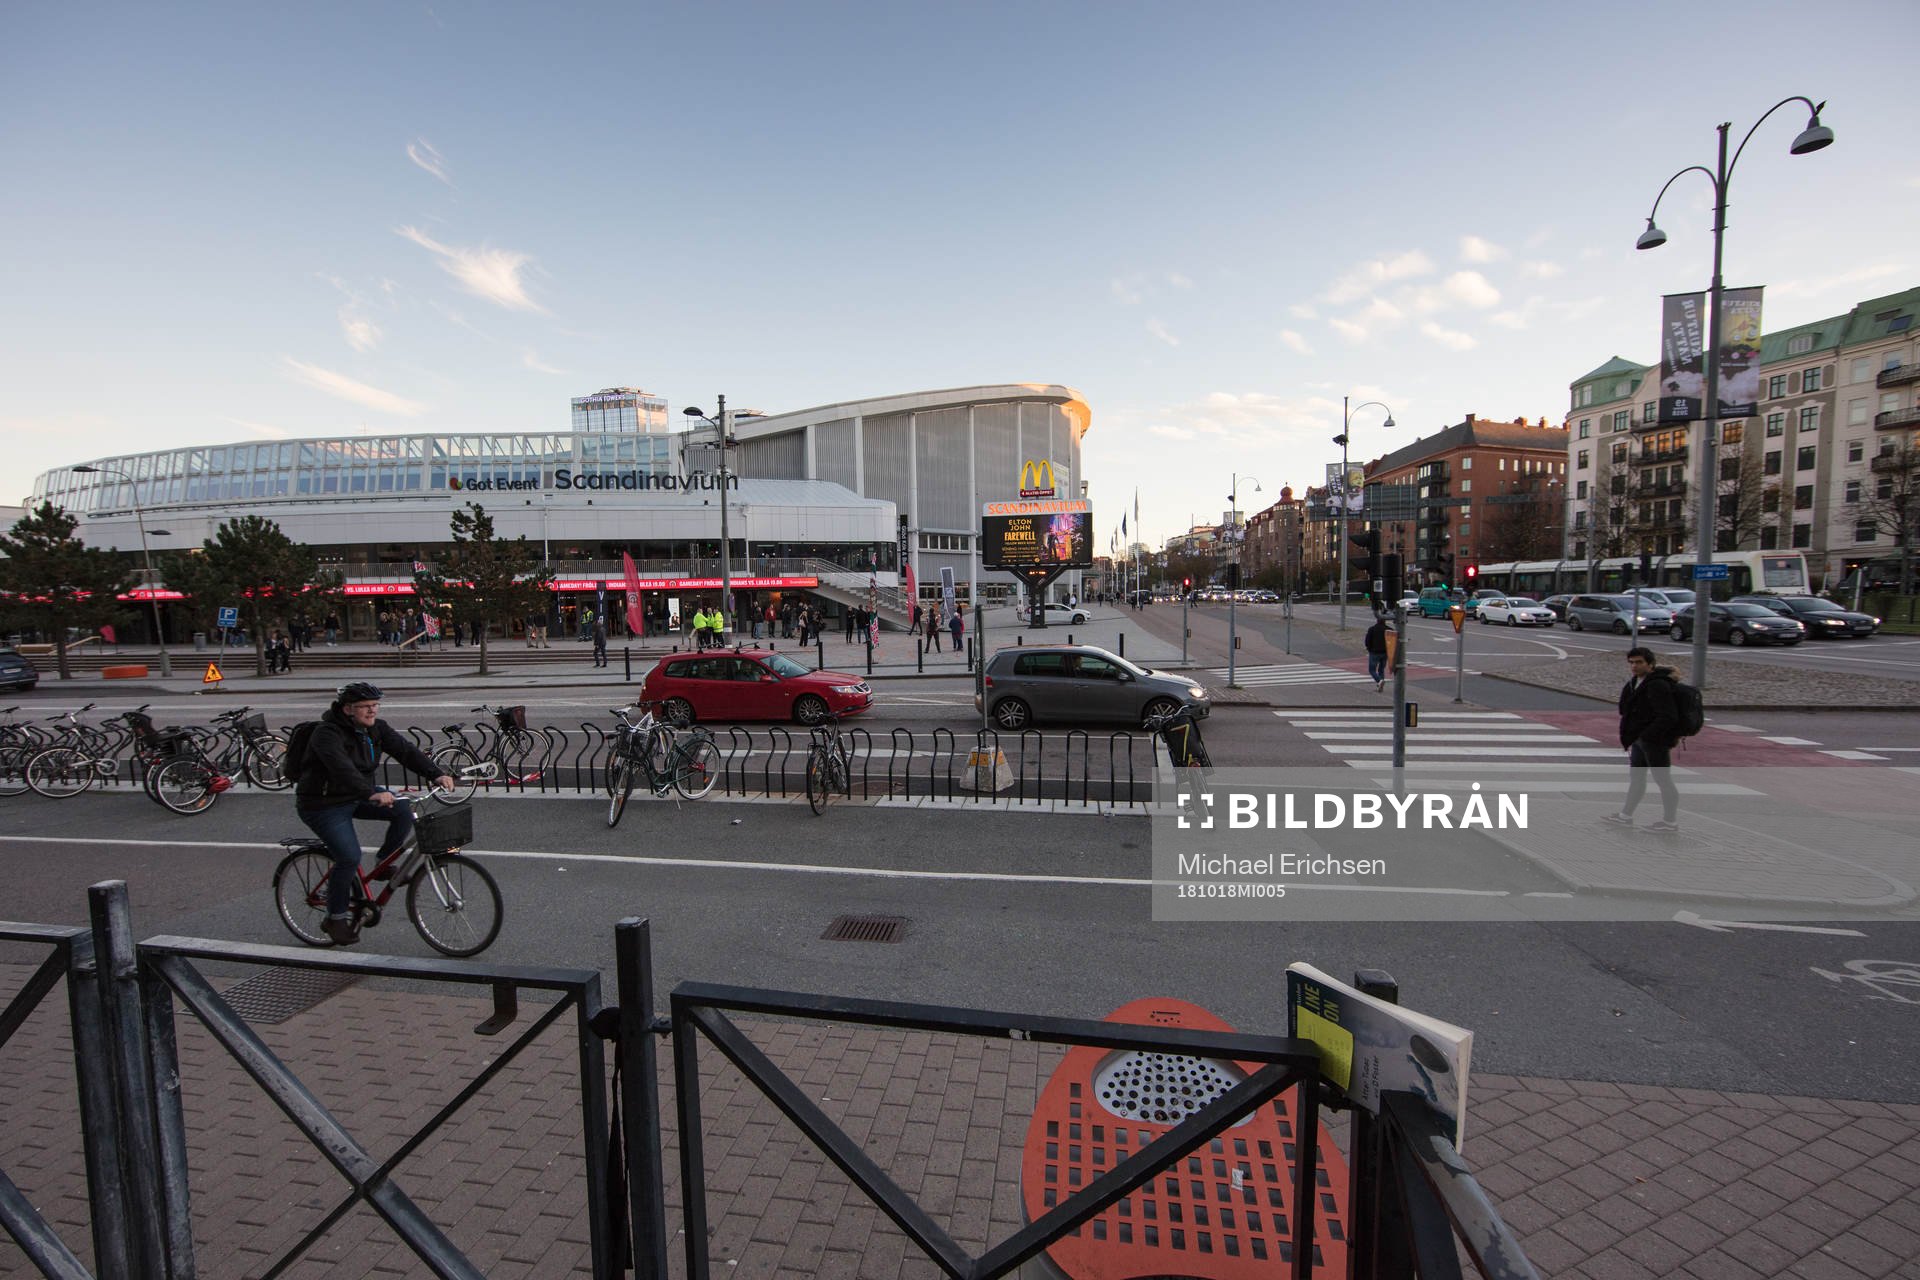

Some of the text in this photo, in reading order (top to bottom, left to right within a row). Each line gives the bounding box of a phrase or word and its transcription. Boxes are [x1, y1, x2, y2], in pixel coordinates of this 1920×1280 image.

[466, 477, 539, 491] Got Event
[554, 469, 739, 491] Scandinavium
[988, 501, 1088, 515] SCANDINAVIUM
[1004, 531, 1036, 541] FAREWELL
[224, 609, 234, 619] P
